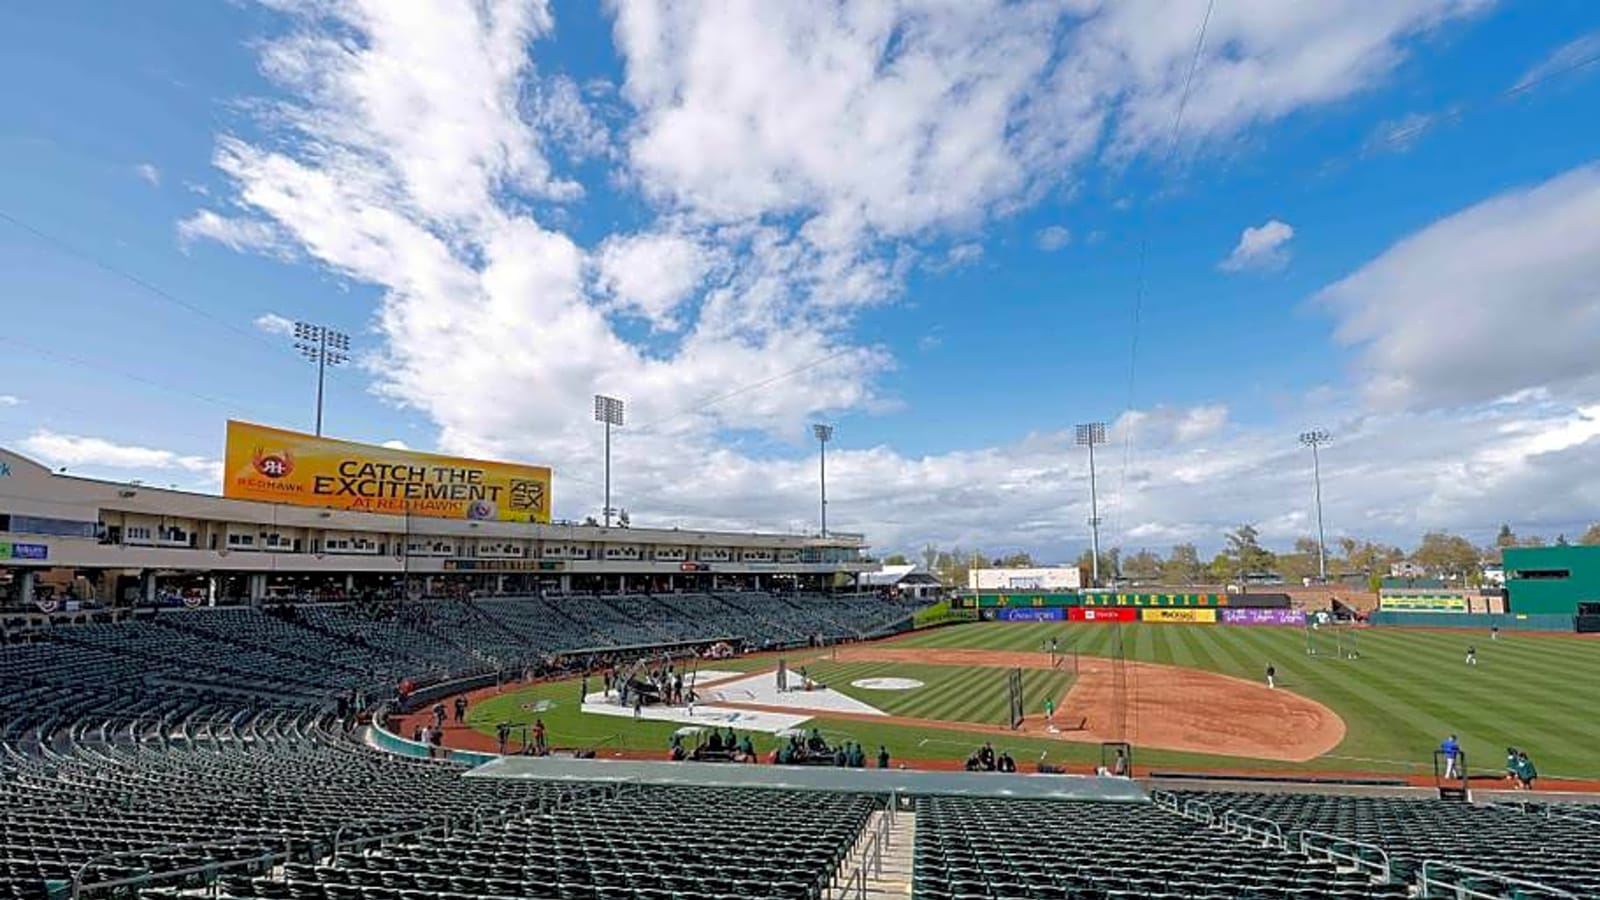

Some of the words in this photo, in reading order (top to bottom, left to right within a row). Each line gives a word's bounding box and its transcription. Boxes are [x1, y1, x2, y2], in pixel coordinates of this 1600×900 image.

[339, 461, 425, 481] CATCH
[432, 467, 484, 484] THE
[313, 475, 503, 502] EXCITEMENT
[352, 498, 371, 508] AT
[376, 499, 410, 511] RED
